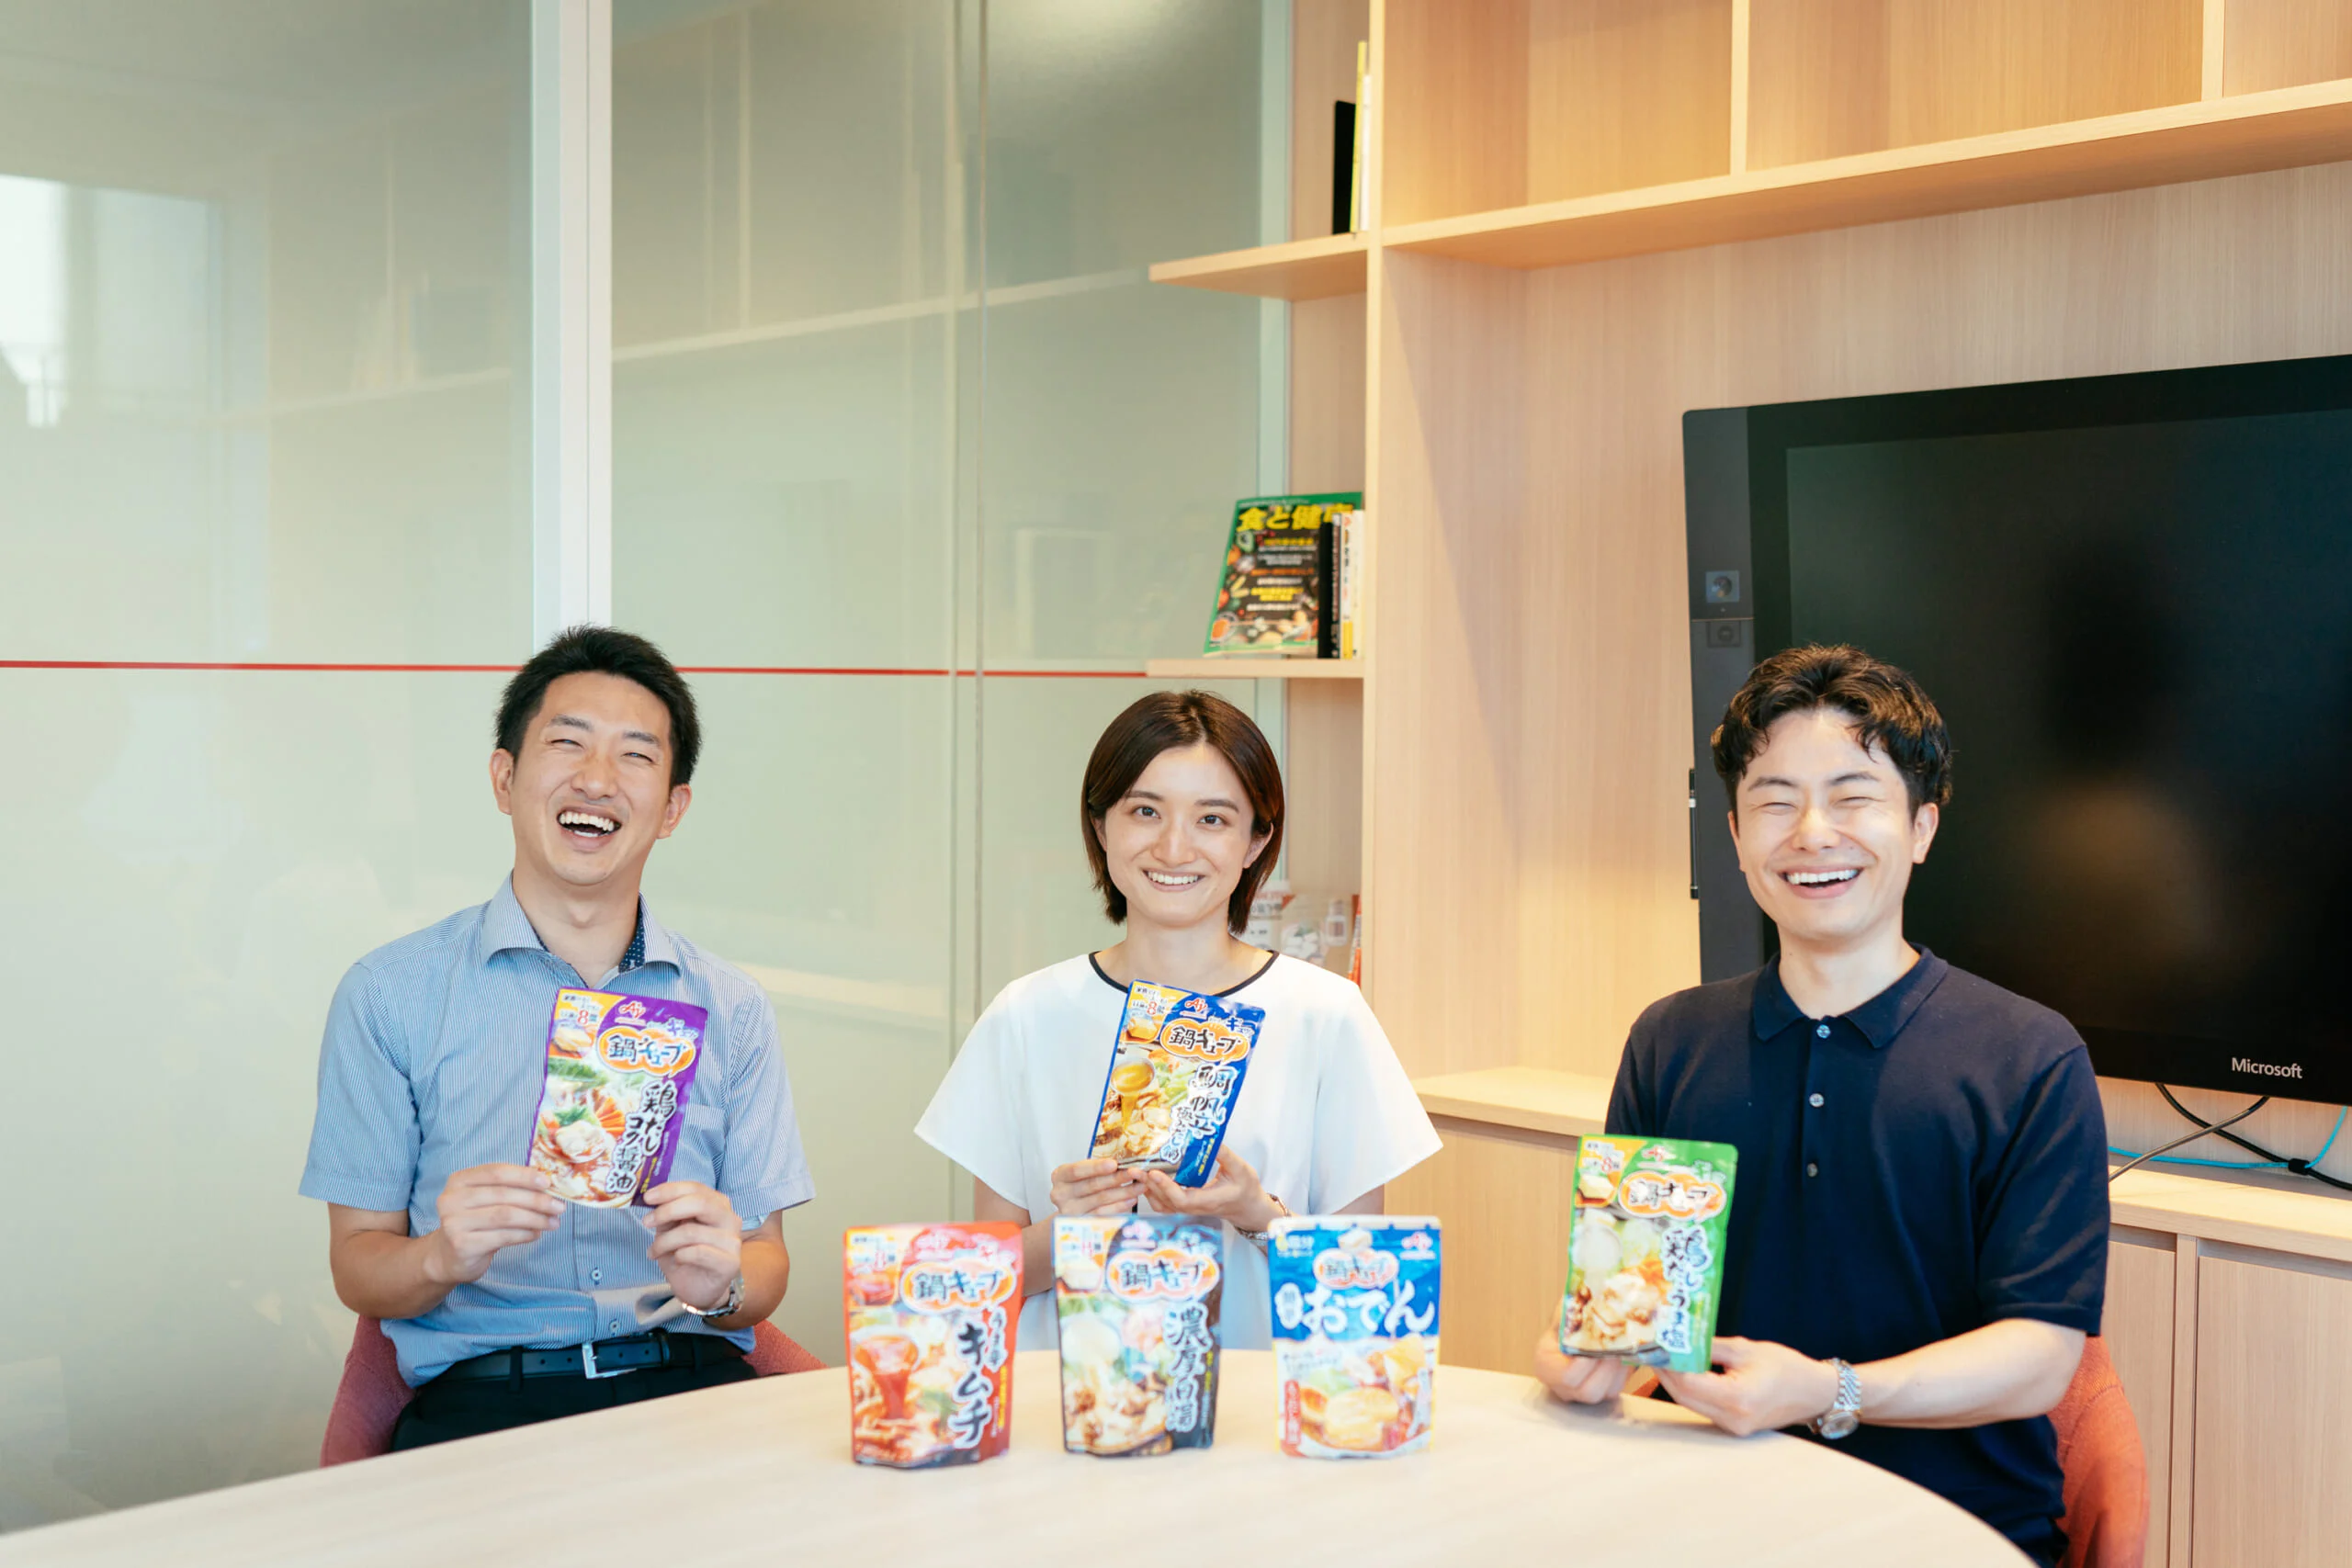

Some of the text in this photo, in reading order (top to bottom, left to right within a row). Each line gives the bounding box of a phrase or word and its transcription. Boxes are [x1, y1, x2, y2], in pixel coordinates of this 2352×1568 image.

[609, 1034, 687, 1066] 鍋キューブ
[1169, 1026, 1241, 1055] 鍋キューブ
[2231, 1057, 2303, 1079] Microsoft
[1303, 1280, 1435, 1333] おでん
[954, 1321, 989, 1442] キムチ
